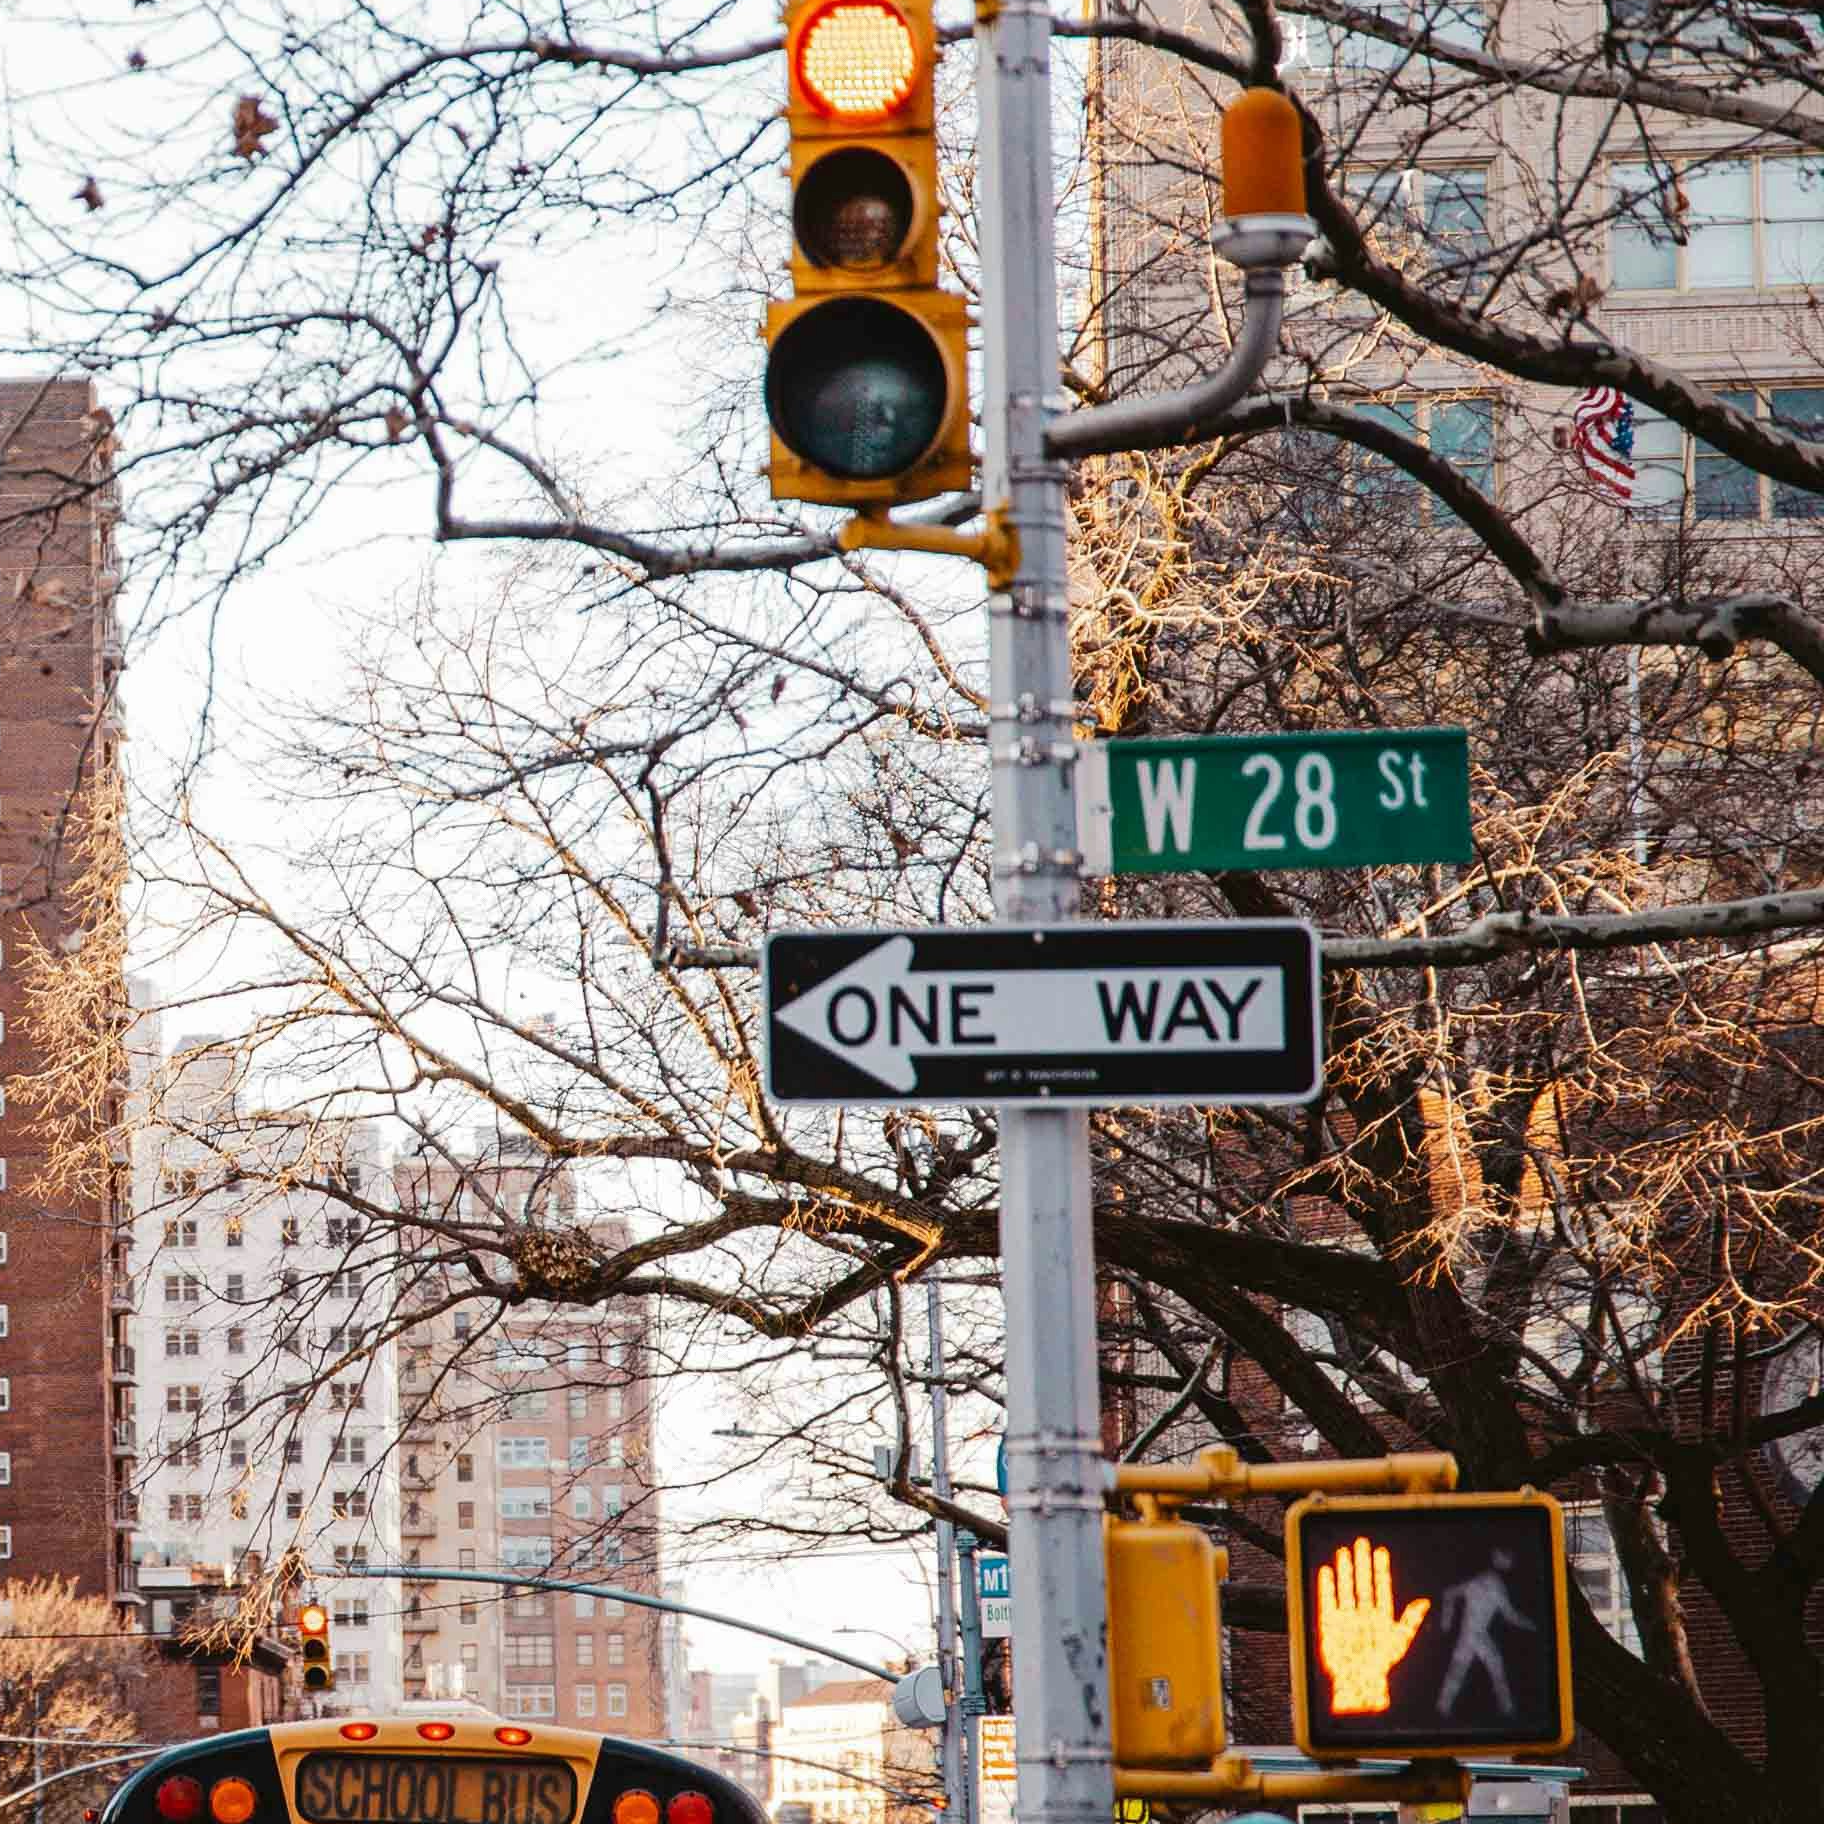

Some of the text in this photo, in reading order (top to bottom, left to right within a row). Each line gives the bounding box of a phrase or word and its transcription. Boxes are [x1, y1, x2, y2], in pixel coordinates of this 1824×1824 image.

[1136, 749, 1430, 854] W 28 St
[826, 978, 1263, 1047] ONE WAY
[304, 1760, 475, 1823] SCHOOL
